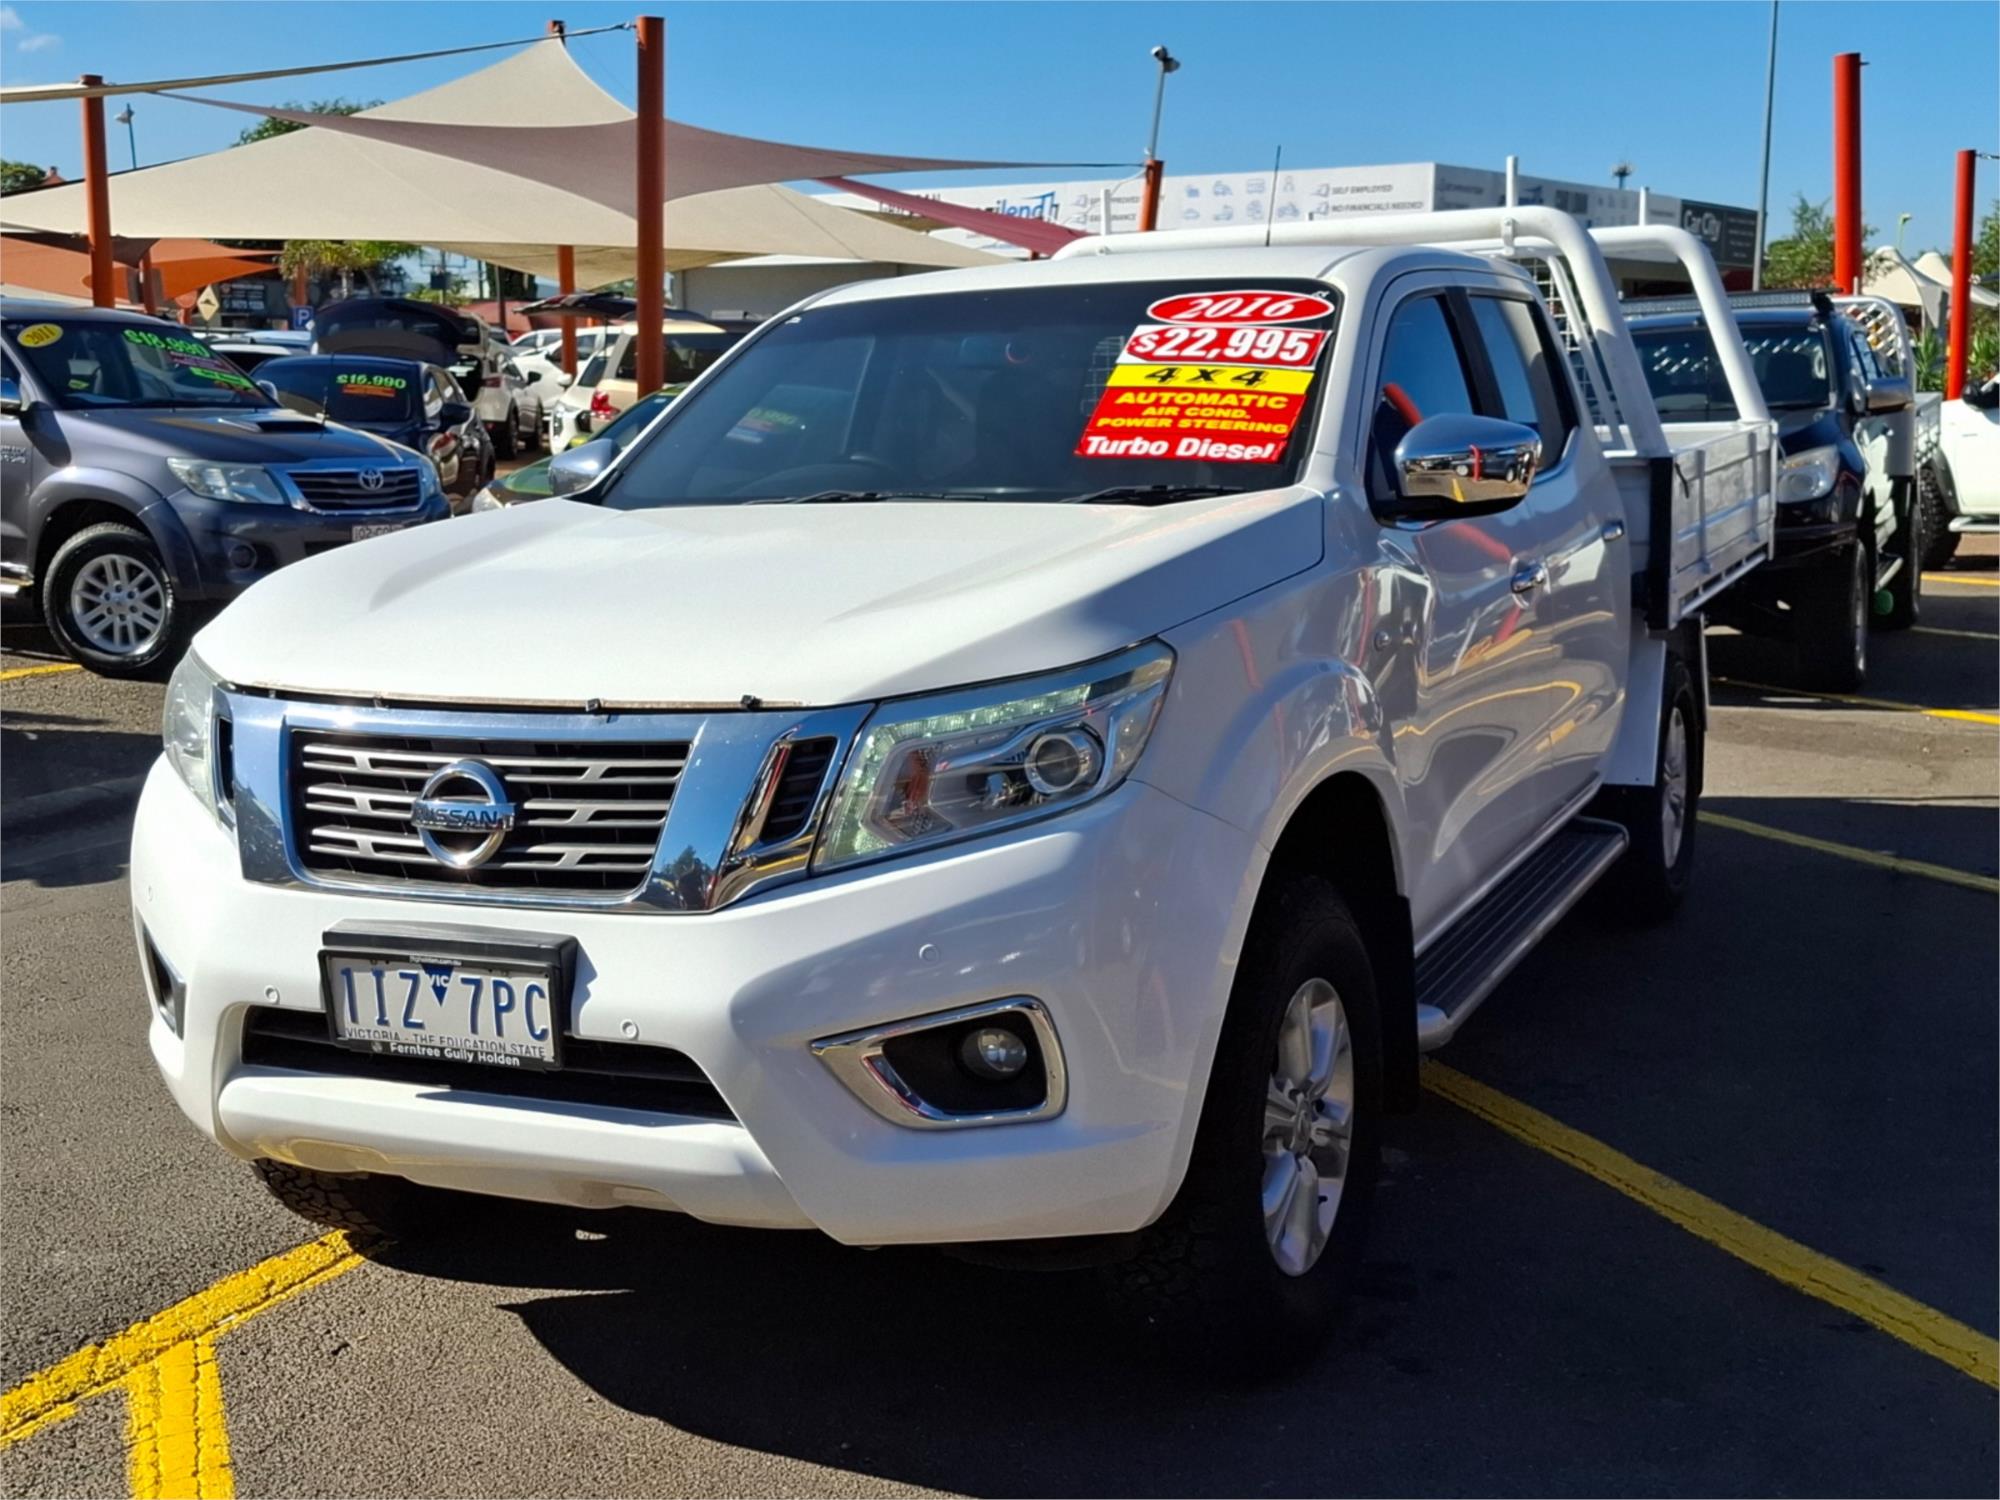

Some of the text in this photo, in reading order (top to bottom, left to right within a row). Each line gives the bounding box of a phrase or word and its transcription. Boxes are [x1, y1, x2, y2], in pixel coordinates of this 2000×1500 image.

[298, 309, 310, 326] P
[1171, 297, 1297, 320] 2016
[1133, 327, 1315, 363] $22,995
[1115, 392, 1289, 410] AUTOMATIC
[1142, 406, 1251, 419] AIR COND.
[1096, 417, 1289, 434] POWER STEERING
[1087, 436, 1276, 460] Turbo Diesel
[415, 805, 498, 825] NISSAN
[428, 972, 450, 987] VIC
[346, 1028, 400, 1041] VICTORIA
[413, 1033, 435, 1044] THE
[439, 1036, 506, 1054] EDUCATION
[511, 1043, 546, 1058] STATE
[389, 1042, 521, 1067] Ferntree Gully Holden
